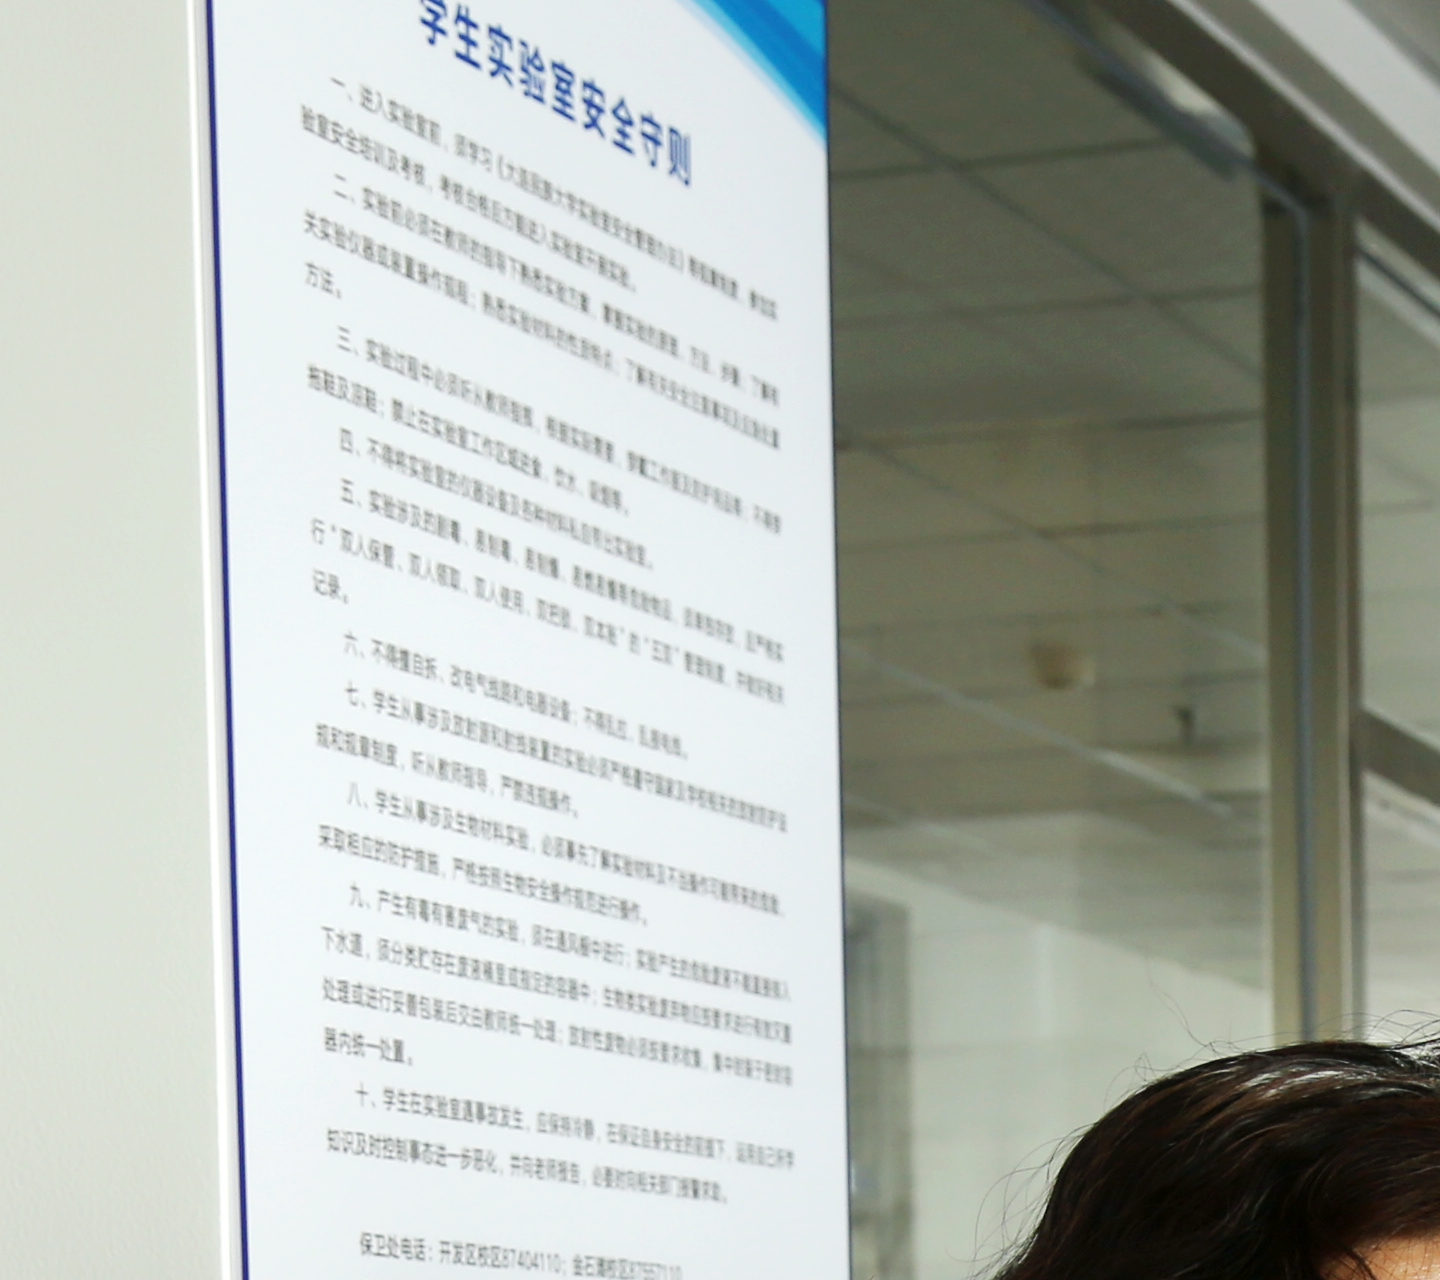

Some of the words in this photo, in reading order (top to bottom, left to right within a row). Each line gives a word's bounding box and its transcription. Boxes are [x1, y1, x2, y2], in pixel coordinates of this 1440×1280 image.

[420, 0, 691, 186] 学生实验室安全守则
[305, 262, 340, 299] 方法。
[313, 569, 347, 603] 记录。
[324, 1026, 412, 1065] 器内统一处置。
